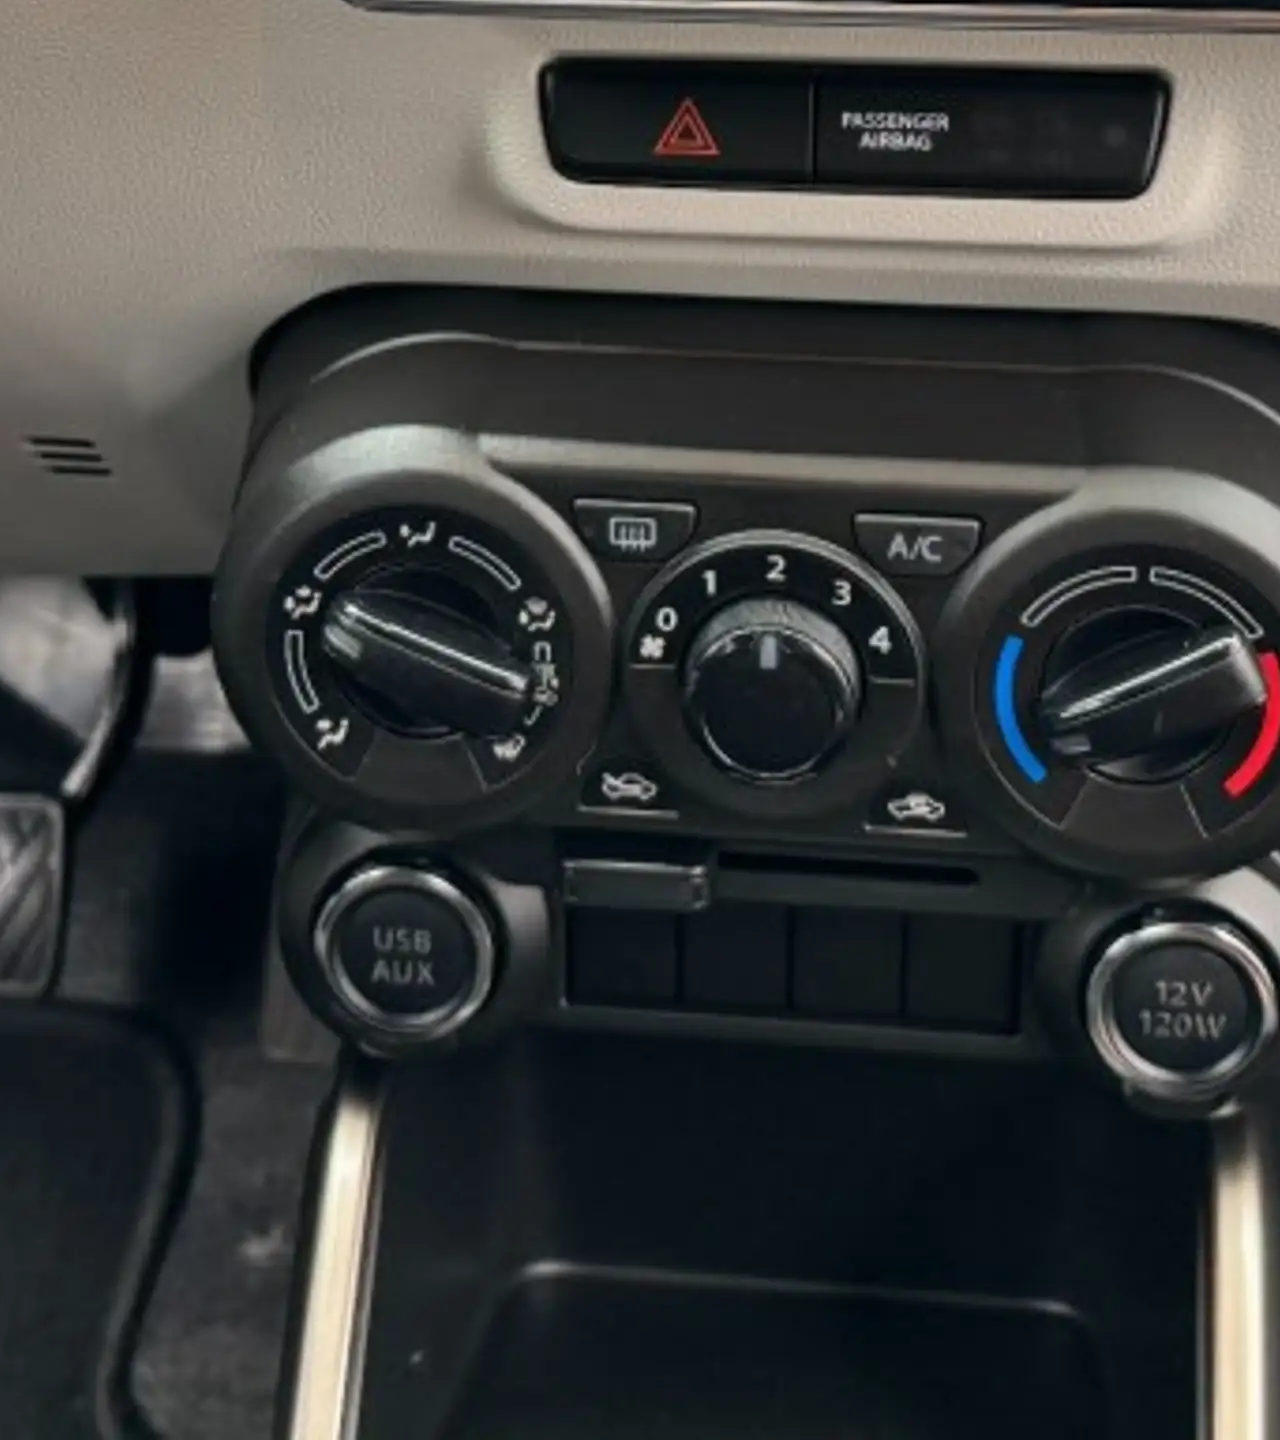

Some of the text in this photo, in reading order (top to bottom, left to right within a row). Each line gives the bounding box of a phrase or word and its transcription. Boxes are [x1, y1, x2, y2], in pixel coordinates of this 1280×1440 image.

[841, 111, 949, 131] PASSENGER
[858, 130, 933, 151] AIRBAG
[887, 535, 944, 563] A/C
[765, 555, 787, 579] 2
[702, 570, 717, 594] 1
[832, 580, 853, 606] 3
[656, 607, 678, 632] 0
[869, 626, 892, 654] 4
[373, 926, 432, 955] USB
[371, 957, 435, 986] AUX
[1156, 980, 1213, 1007] 12V
[1138, 1008, 1228, 1040] 120W
